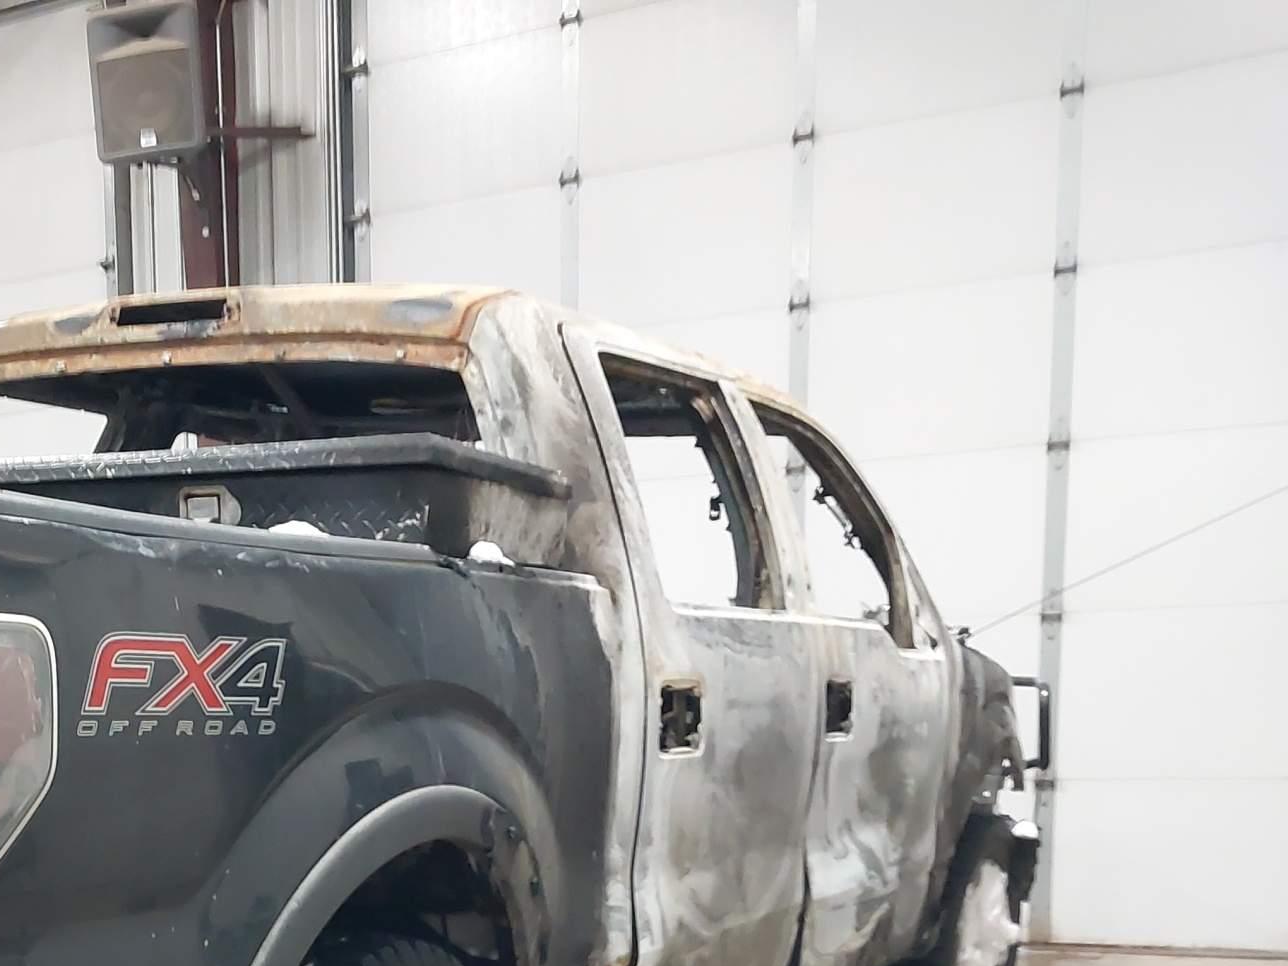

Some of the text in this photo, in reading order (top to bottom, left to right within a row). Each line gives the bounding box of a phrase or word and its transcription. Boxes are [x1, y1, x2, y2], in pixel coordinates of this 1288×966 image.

[81, 631, 287, 716] FX4
[76, 719, 277, 737] OFF ROAD
